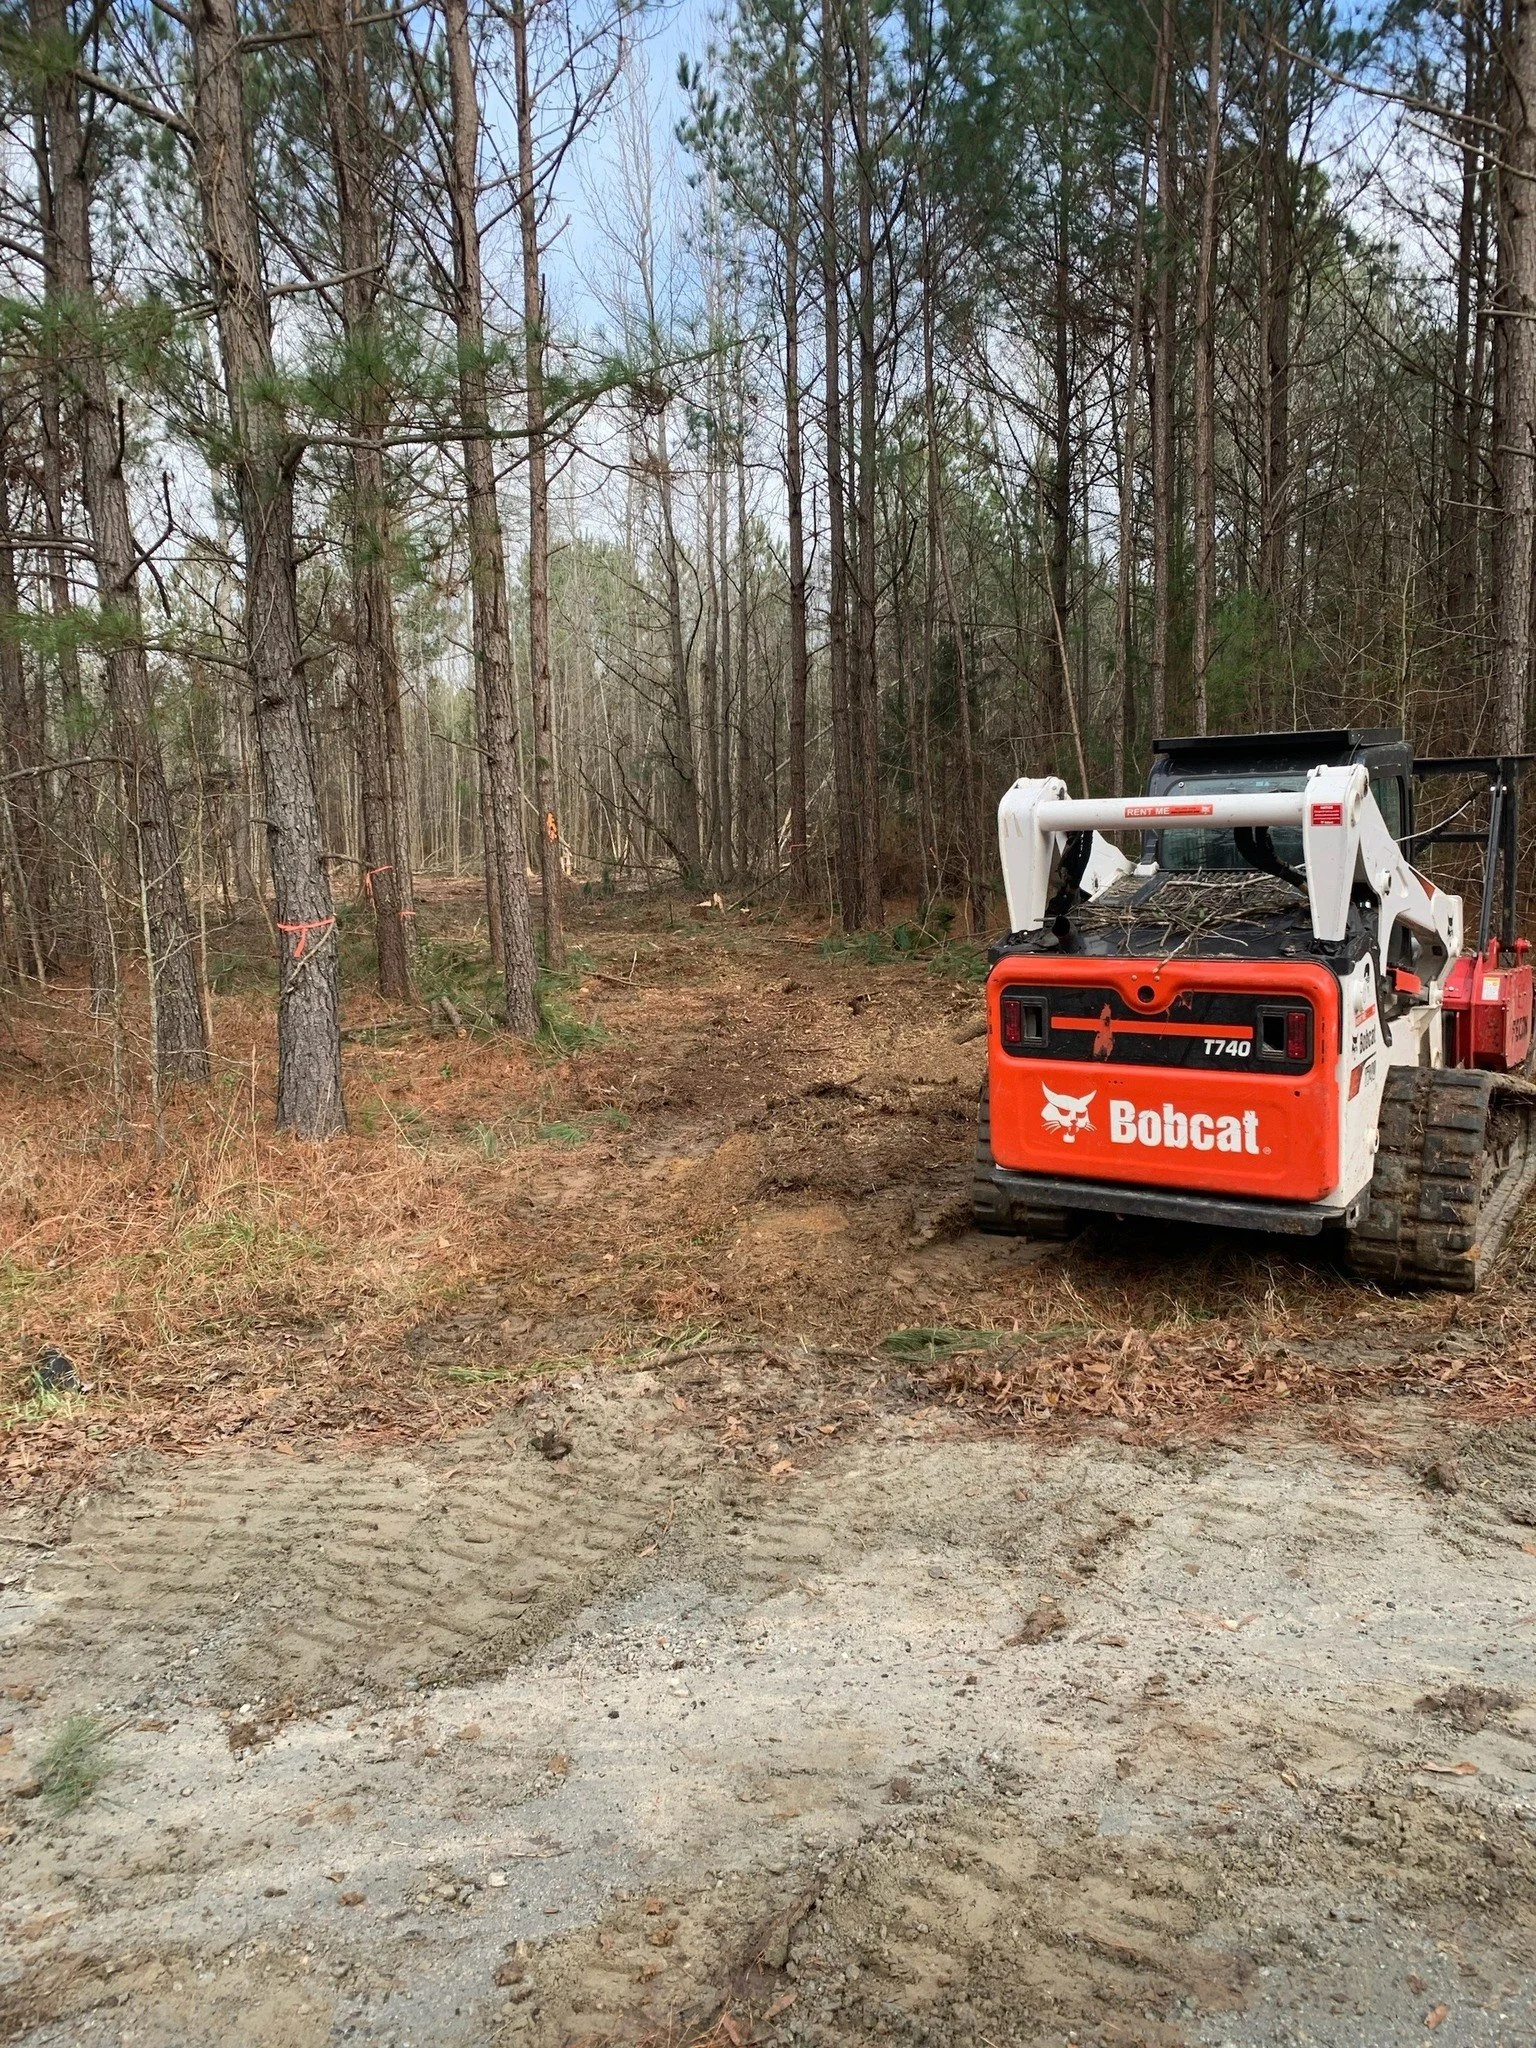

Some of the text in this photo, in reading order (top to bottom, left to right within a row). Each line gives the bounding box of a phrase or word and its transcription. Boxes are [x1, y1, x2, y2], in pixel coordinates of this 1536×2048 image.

[1126, 807, 1152, 816] RENT
[1155, 806, 1170, 815] ME
[1204, 1039, 1250, 1057] T740
[1109, 1099, 1259, 1154] Bobcat
